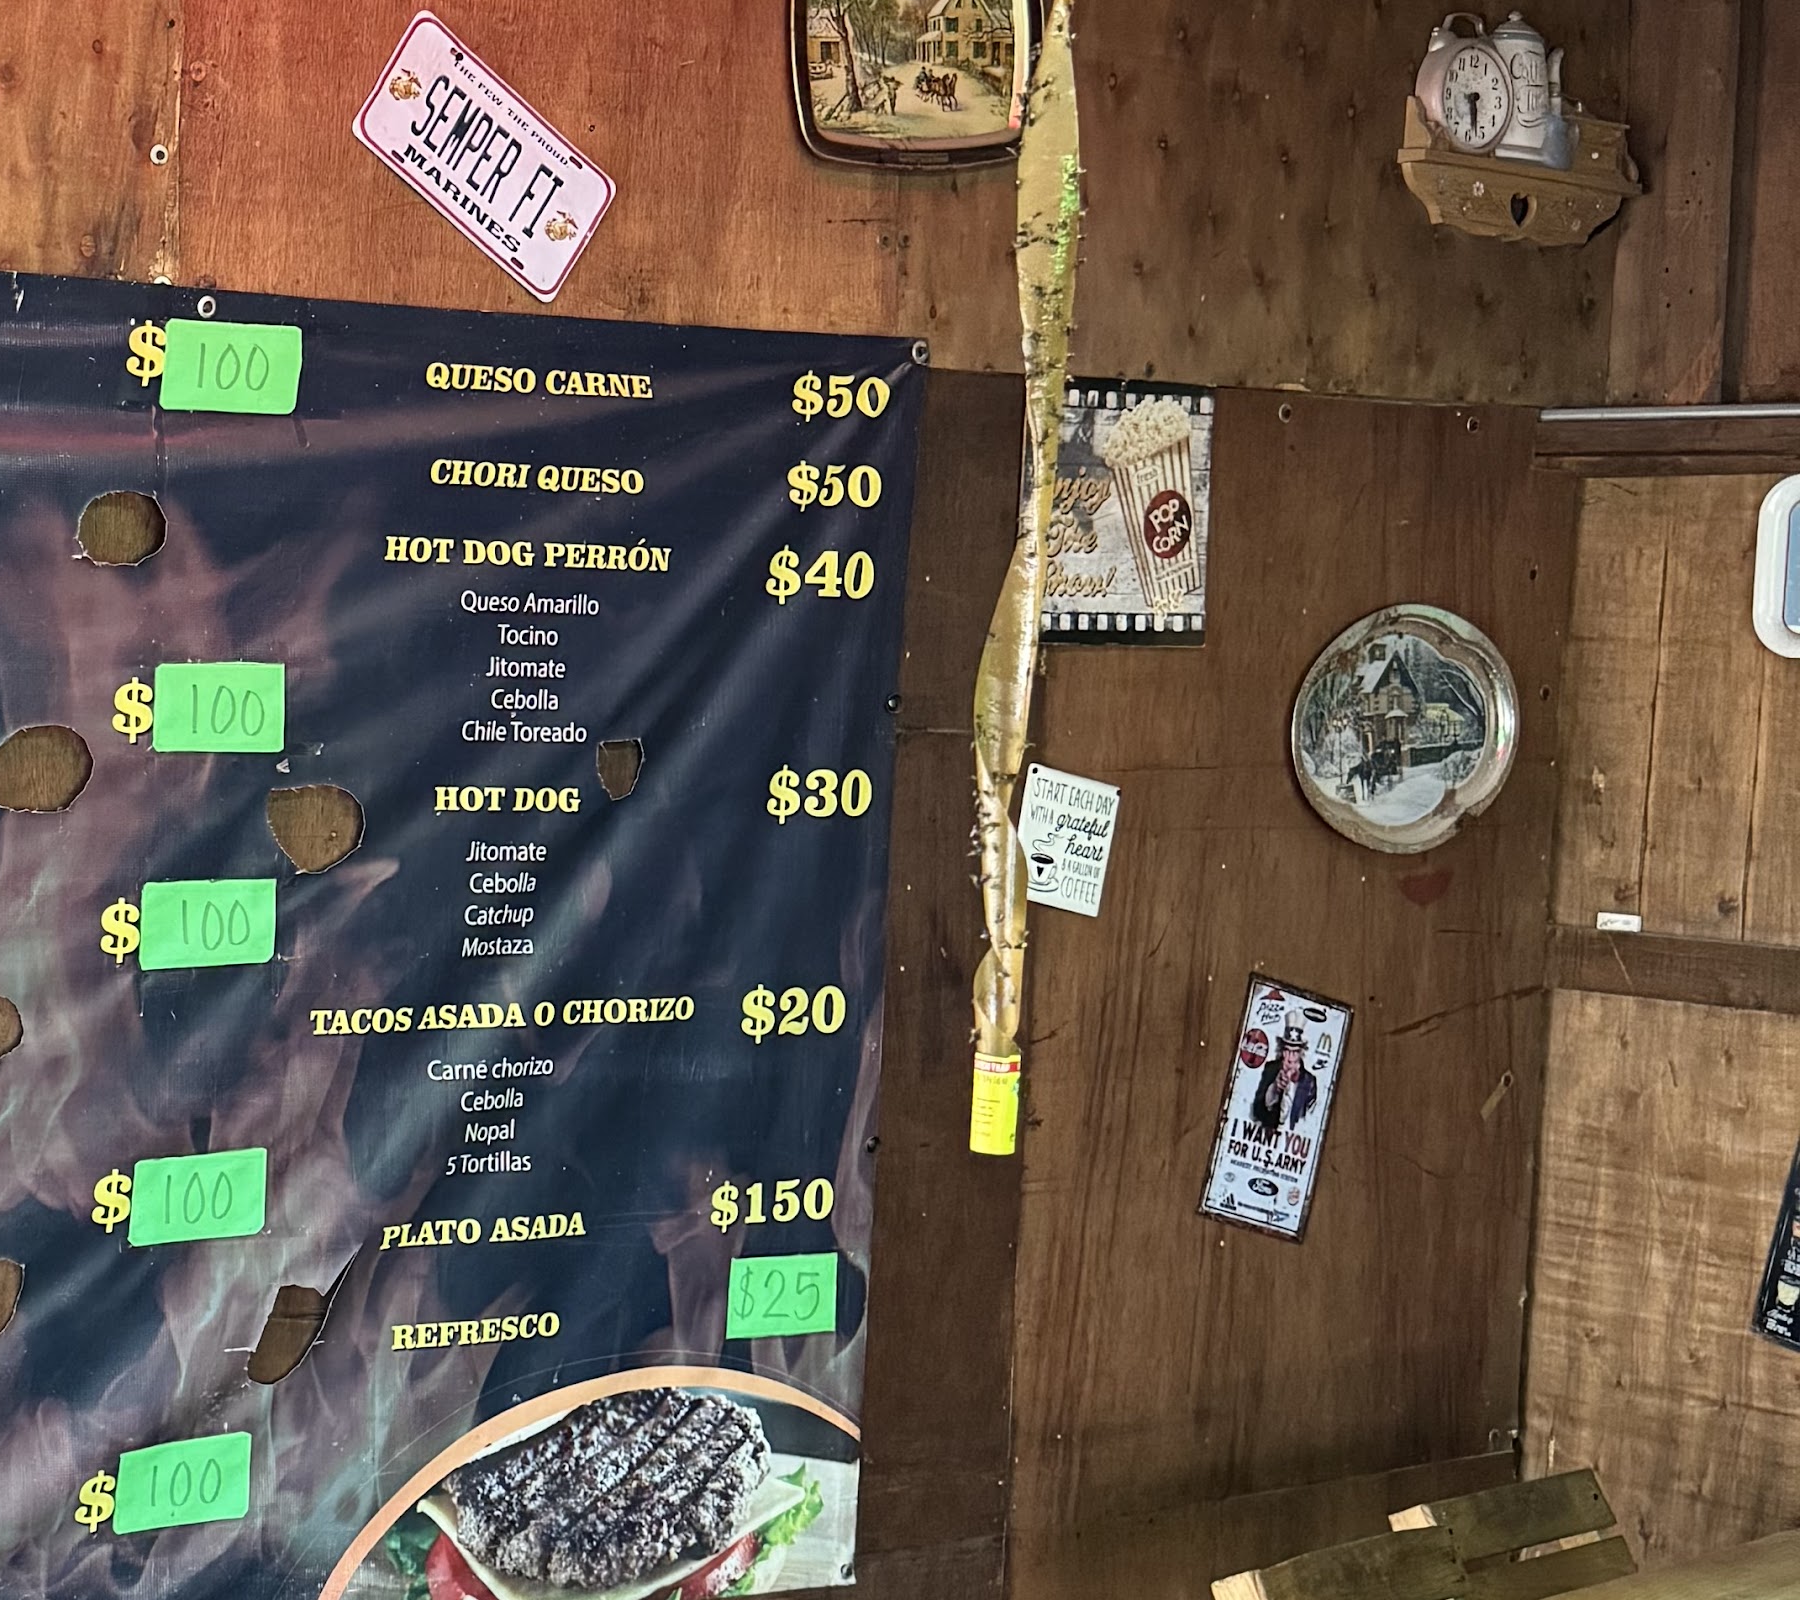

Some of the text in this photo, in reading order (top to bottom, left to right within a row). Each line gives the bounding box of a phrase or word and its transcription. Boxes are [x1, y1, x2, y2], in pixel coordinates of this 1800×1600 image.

[452, 59, 476, 84] THE
[507, 107, 529, 131] THE
[411, 75, 564, 239] SEMPER FI
[403, 144, 521, 253] MARINES
[197, 342, 270, 393] 100
[425, 362, 892, 422] QUESO CARNE $50
[430, 458, 883, 512] CHORI QUESO $50
[1052, 466, 1111, 515] njoy
[1149, 499, 1180, 533] POP
[1152, 515, 1189, 553] CORN
[384, 535, 876, 605] HOT DOG PERRÓN $40
[460, 590, 600, 616] Queso Amarillo
[497, 623, 559, 648] Tocino
[485, 655, 566, 681] Jitomate
[192, 683, 266, 737] 100
[491, 688, 559, 712] Cebolla
[461, 720, 588, 745] Chile Toreado
[434, 764, 872, 824] HOT DOG $30
[1034, 778, 1116, 816] START EACH DAY
[1030, 805, 1048, 823] WITH
[1055, 814, 1111, 841] grateful
[1065, 834, 1103, 861] heart
[1060, 875, 1099, 905] COFFEE
[180, 899, 252, 953] 100
[310, 984, 847, 1043] TACOS ASADA O CHORIZO $20
[491, 1054, 555, 1079] chorizo
[460, 1089, 524, 1114] Cebolla
[464, 1119, 516, 1147] Nopal
[1231, 1118, 1311, 1158] I WANT YOU
[446, 1150, 532, 1176] 5 Tortillas
[1227, 1139, 1249, 1158] FOR
[1274, 1153, 1307, 1175] ARMY
[163, 1171, 234, 1226] 100
[378, 1178, 835, 1251] PLATO ASADA $150
[734, 1270, 822, 1322] $25
[391, 1311, 561, 1351] REFRESCO
[149, 1457, 223, 1509] 100
